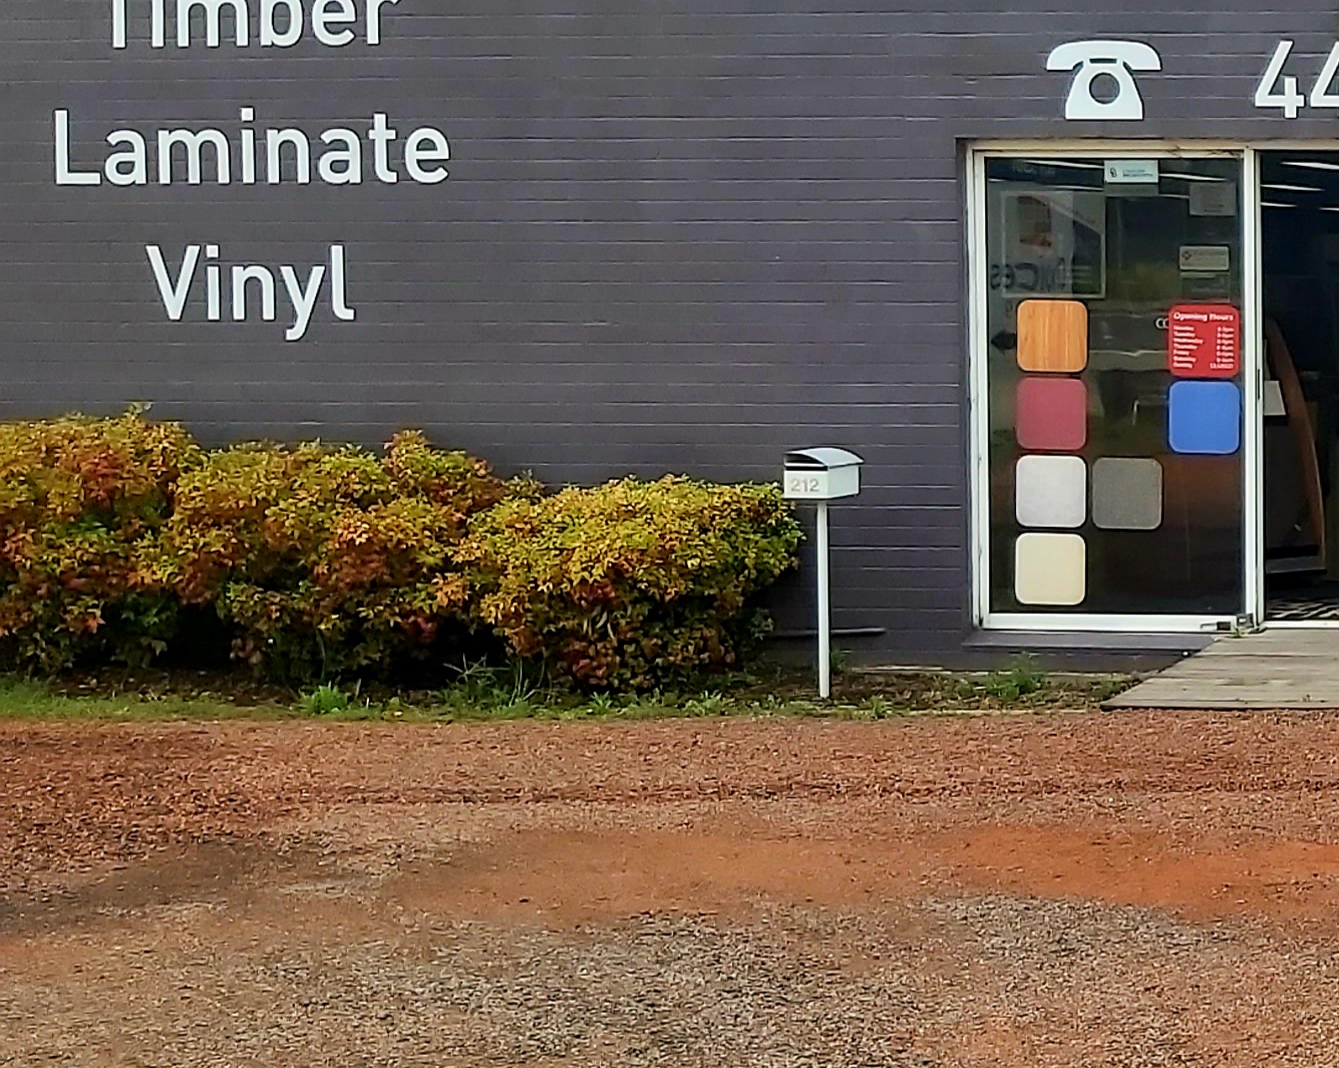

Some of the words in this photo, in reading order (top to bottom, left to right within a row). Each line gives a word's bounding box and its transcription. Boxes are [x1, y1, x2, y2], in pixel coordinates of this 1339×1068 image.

[54, 108, 449, 184] Laminate
[146, 245, 355, 340] Vinyl
[790, 478, 819, 492] 212
